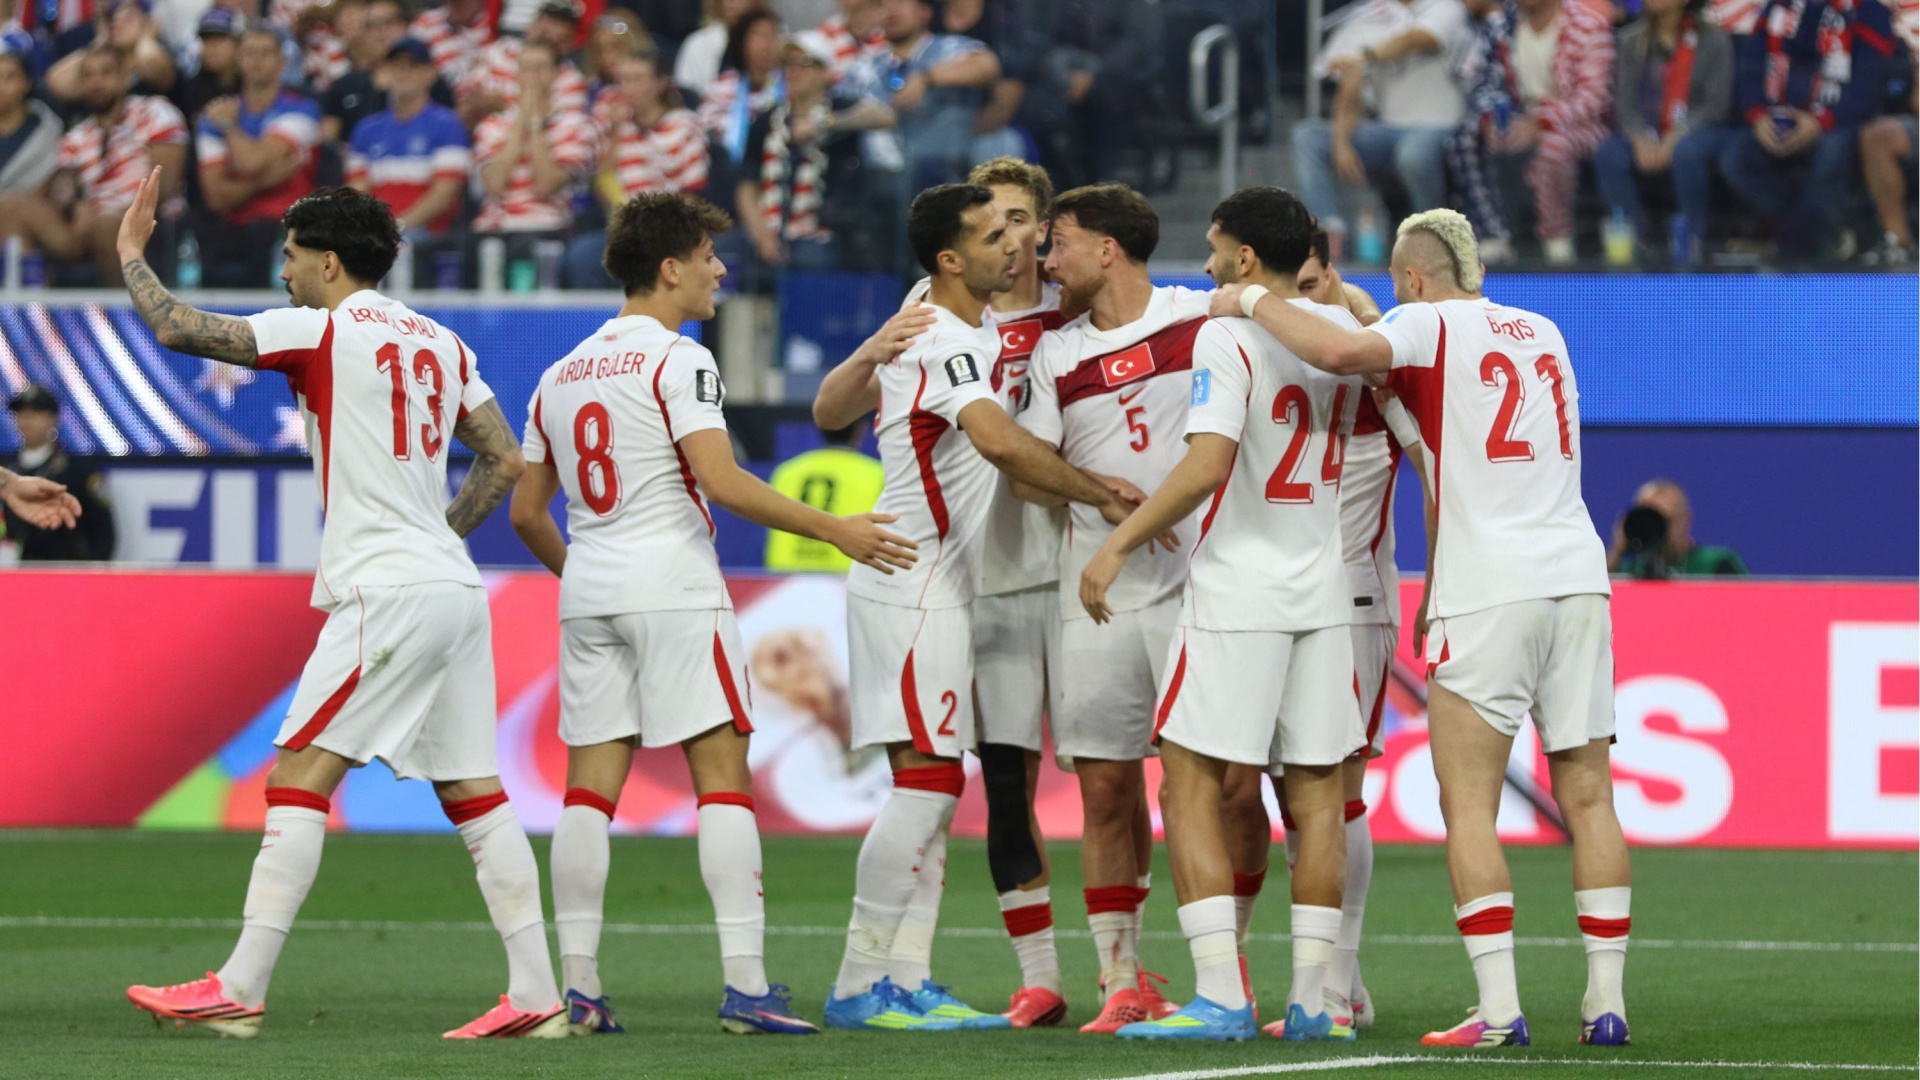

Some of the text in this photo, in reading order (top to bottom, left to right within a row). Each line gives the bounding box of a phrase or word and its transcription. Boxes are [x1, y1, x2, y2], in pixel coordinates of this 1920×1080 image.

[375, 341, 446, 465] 13
[554, 357, 594, 387] ARDA
[1479, 351, 1574, 464] 21
[573, 400, 623, 518] 8
[1125, 405, 1151, 454] 5
[1264, 383, 1351, 505] 24
[937, 689, 958, 738] 2
